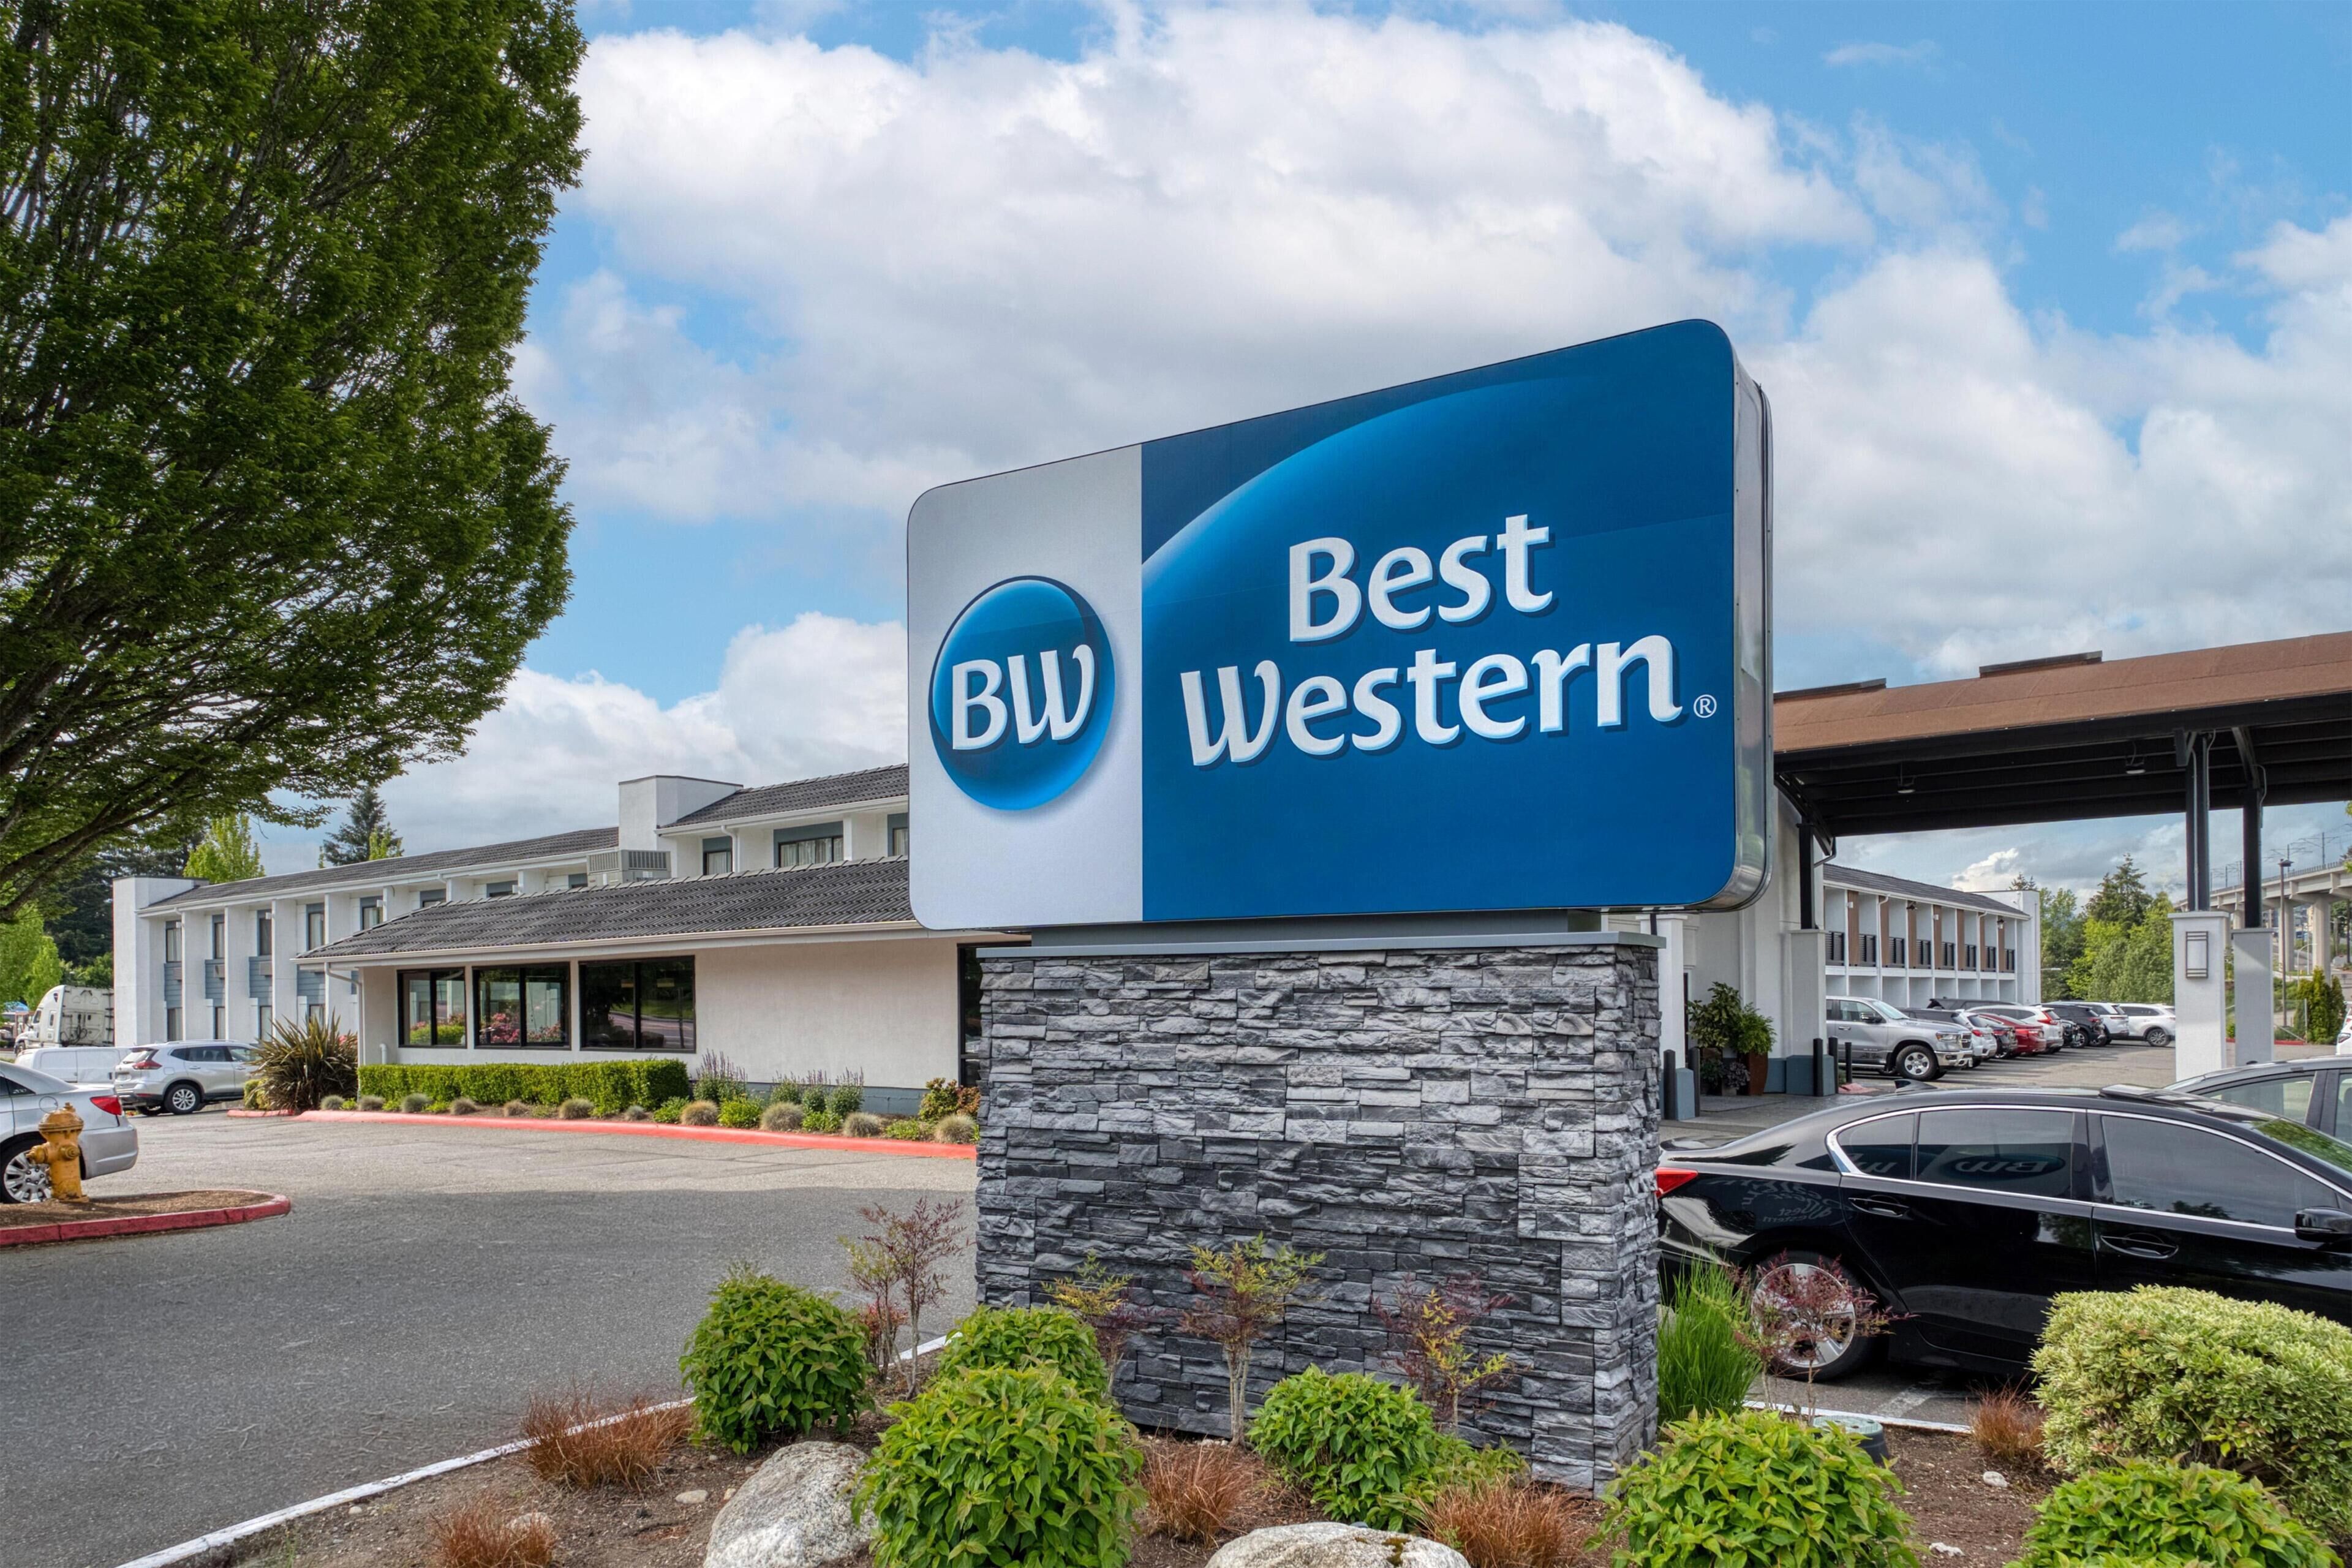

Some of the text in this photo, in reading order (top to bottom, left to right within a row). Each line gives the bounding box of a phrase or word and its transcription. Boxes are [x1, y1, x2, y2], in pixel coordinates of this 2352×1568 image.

[1289, 513, 1553, 643] Best
[951, 644, 1095, 751] BW
[1179, 635, 1684, 767] Western
